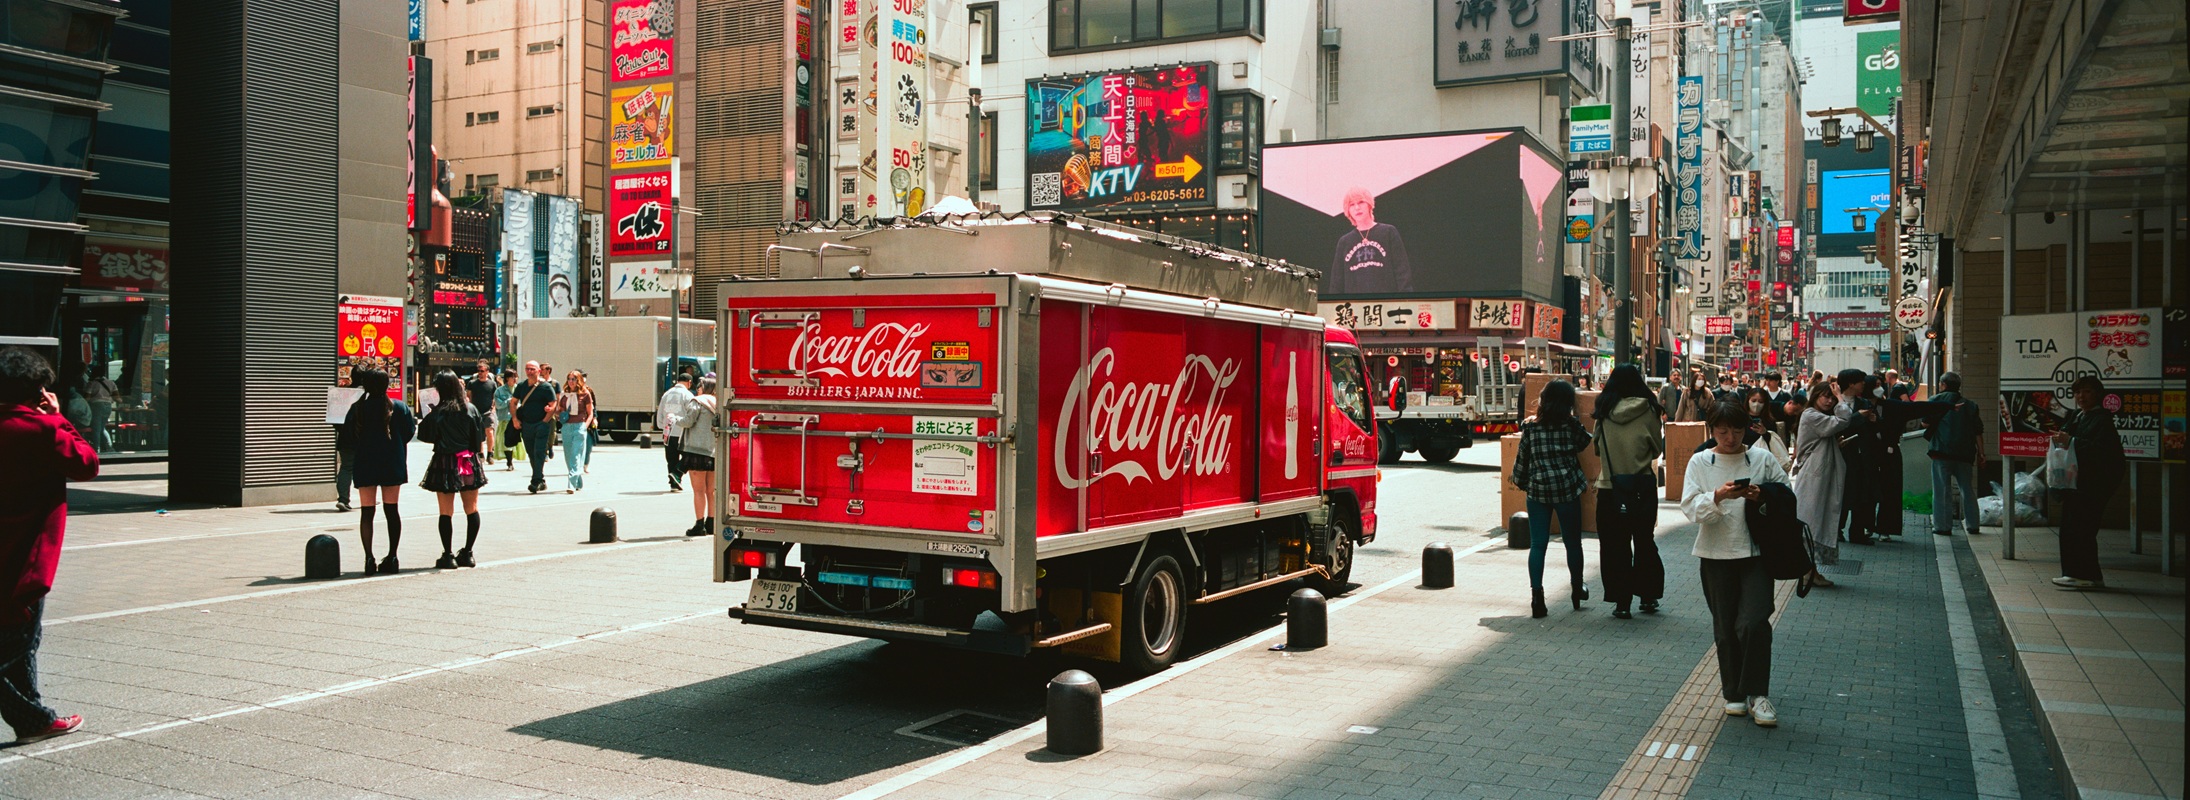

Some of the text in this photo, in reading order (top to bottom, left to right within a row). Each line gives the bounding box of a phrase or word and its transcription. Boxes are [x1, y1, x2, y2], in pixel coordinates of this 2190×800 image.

[616, 4, 655, 22] ダイニング
[616, 30, 657, 43] ダーツバー
[892, 18, 916, 44] 寿司
[891, 41, 913, 65] 100
[1458, 52, 1491, 63] KANKA
[1504, 47, 1540, 58] HOTPOT
[627, 90, 655, 116] 低料金
[842, 88, 856, 132] 大衆
[1103, 76, 1123, 166] 天上人間
[1571, 123, 1609, 134] FamilyMart
[612, 121, 645, 143] 麻雀
[615, 141, 668, 162] ウェルカム
[1587, 141, 1607, 150] たばこ
[893, 148, 910, 169] 50
[1678, 80, 1702, 258] カラオケの鉄人
[1089, 164, 1143, 199] KTV
[1134, 187, 1205, 203] 03-6205-5612
[656, 240, 668, 250] 2F
[99, 249, 168, 282] 銀だこ
[591, 254, 602, 305] にいむら
[1898, 309, 1926, 318] ラーメン
[2096, 314, 2142, 327] カラオケ
[2015, 338, 2059, 354] TOA
[2087, 329, 2151, 349] まねきねこ
[788, 322, 932, 378] Coca-Cola
[946, 346, 968, 356] 録画中
[787, 384, 924, 400] BOTTLERS JAPAN INC.
[915, 420, 974, 436] お先にどうぞ
[1054, 346, 1243, 490] Coca-Cola
[2113, 414, 2160, 428] ネットカフェ
[1344, 435, 1366, 457] Coca-Cola
